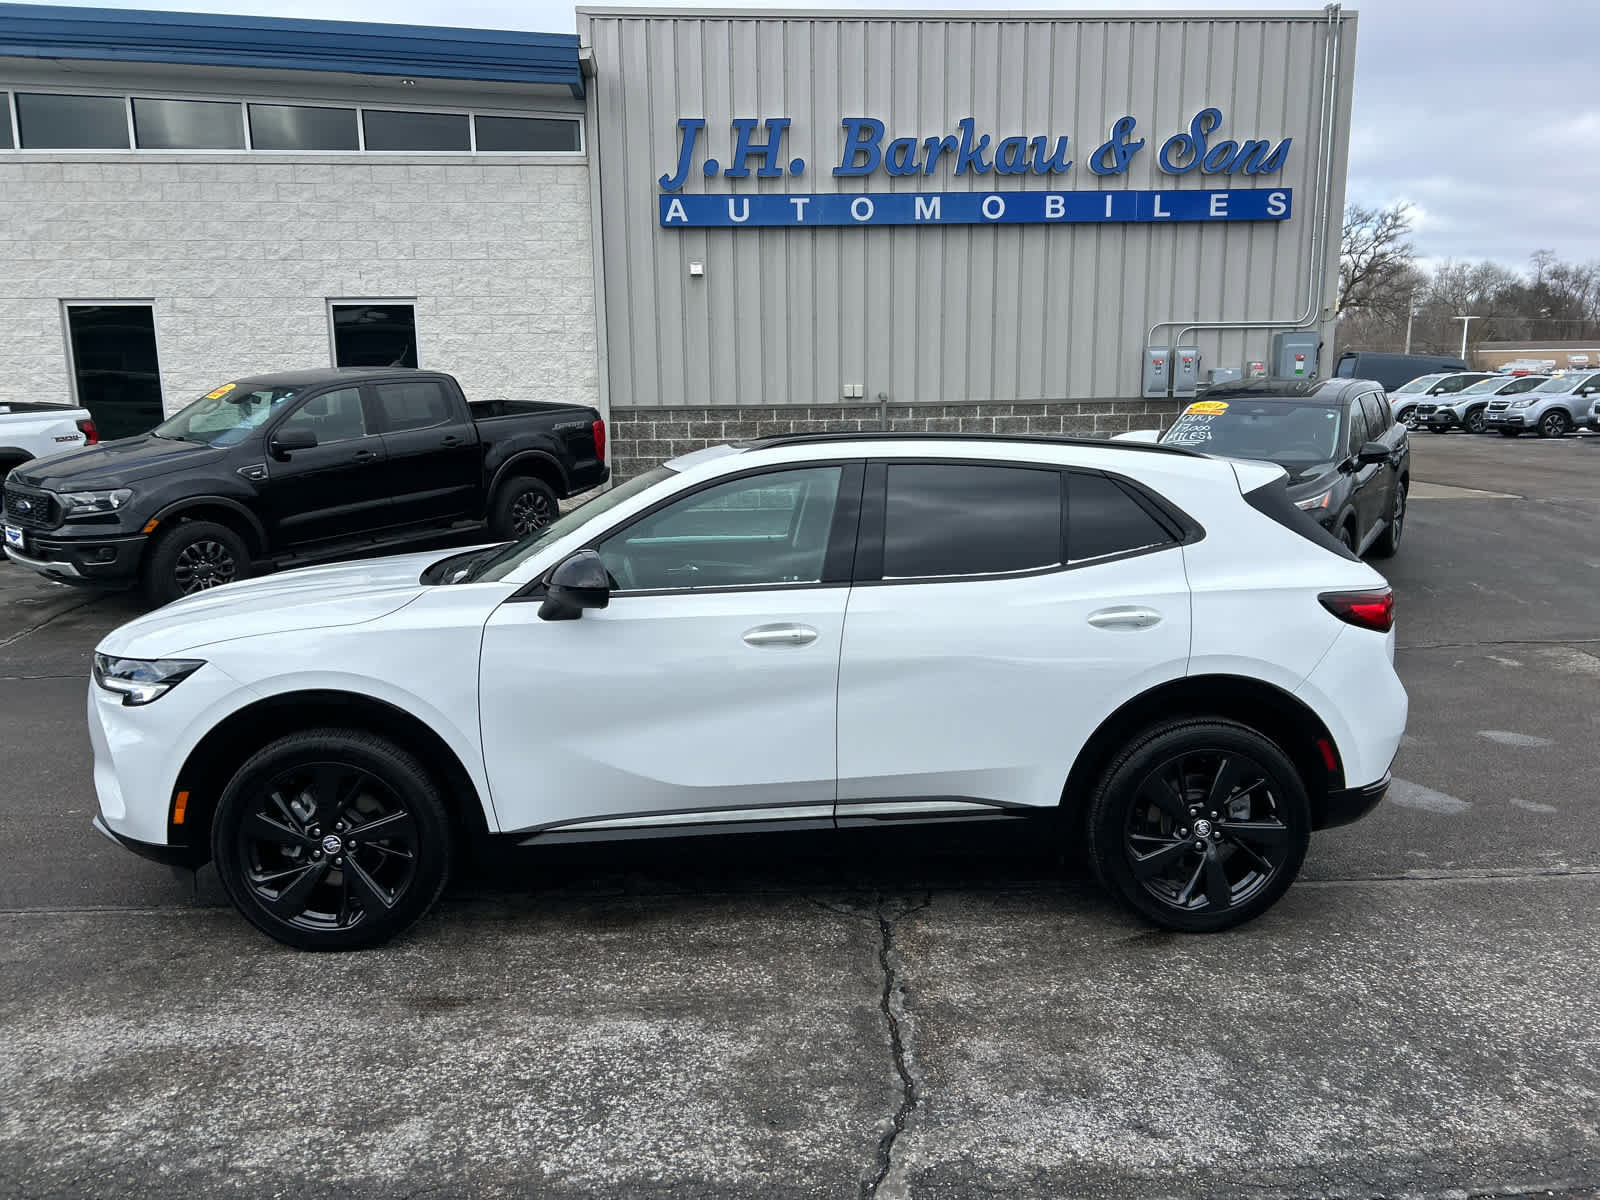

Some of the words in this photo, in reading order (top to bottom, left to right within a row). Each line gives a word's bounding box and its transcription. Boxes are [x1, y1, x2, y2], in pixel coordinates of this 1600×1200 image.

[832, 117, 1073, 177] Barkau
[1087, 115, 1146, 176] &
[1157, 107, 1294, 176] Sons
[664, 192, 1287, 222] AUTOMOBILES
